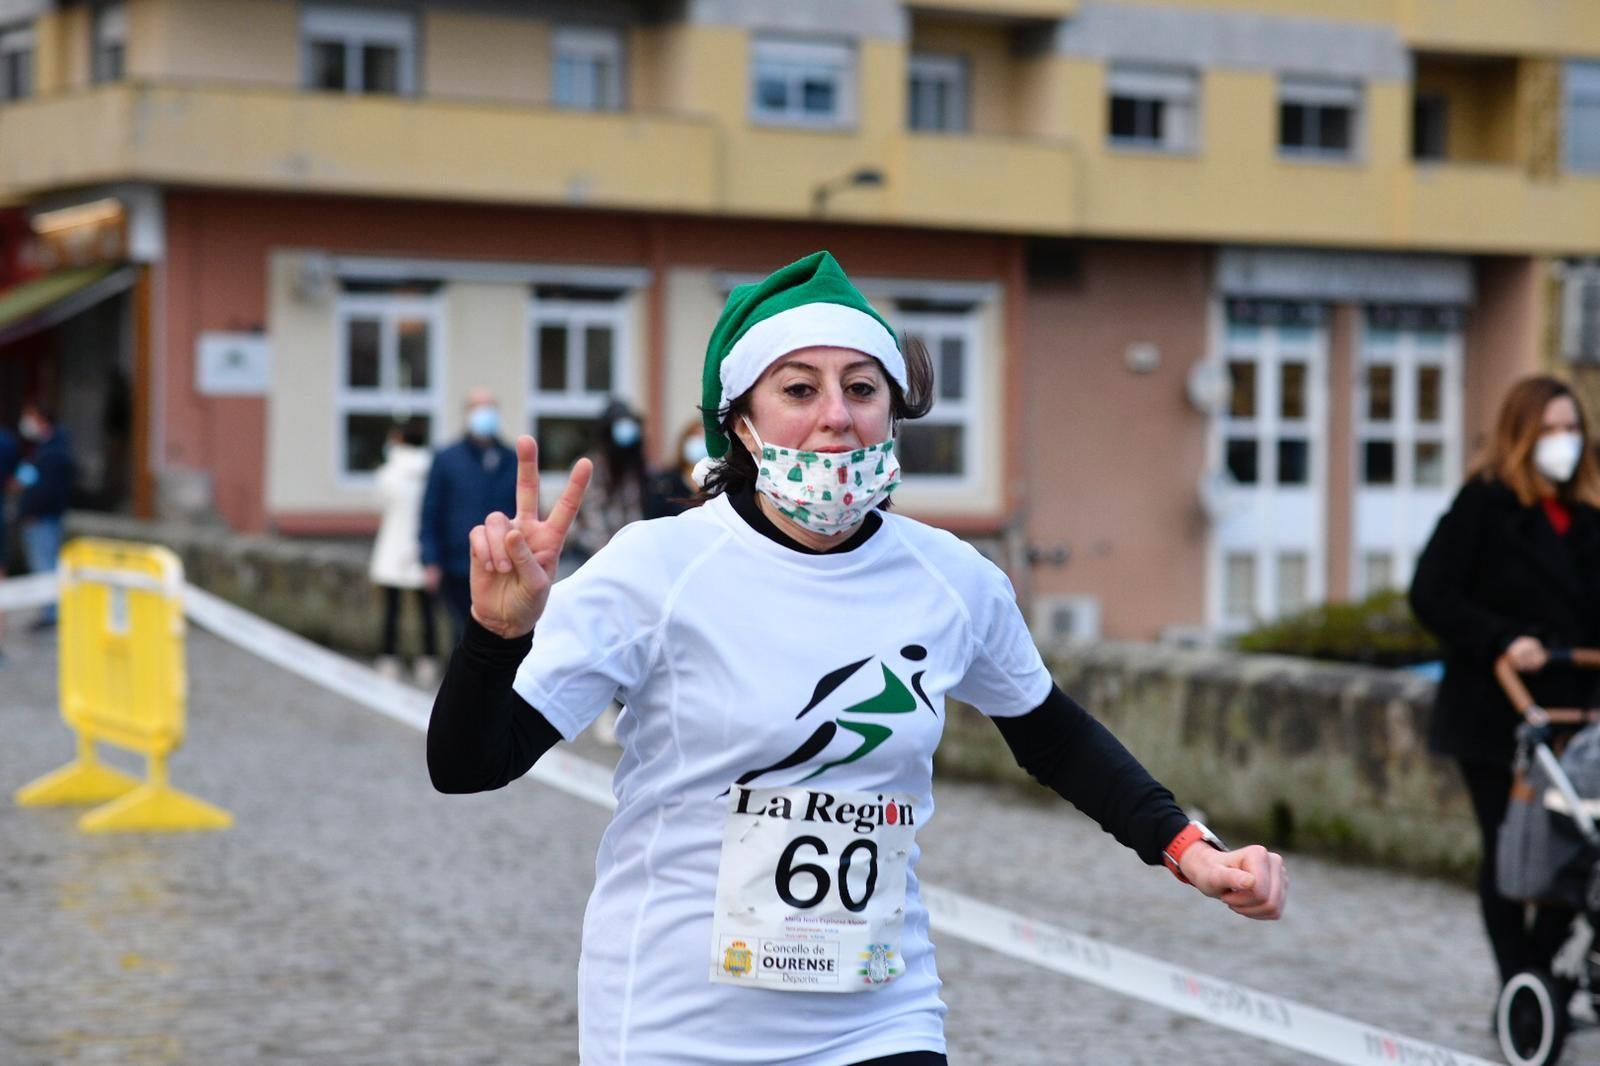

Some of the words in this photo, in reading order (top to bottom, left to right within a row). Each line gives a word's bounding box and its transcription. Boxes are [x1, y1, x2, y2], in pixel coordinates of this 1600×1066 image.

[735, 788, 792, 820] La
[775, 835, 878, 913] 60
[763, 942, 810, 955] Concello
[812, 945, 825, 955] de
[763, 956, 835, 972] OURENSE
